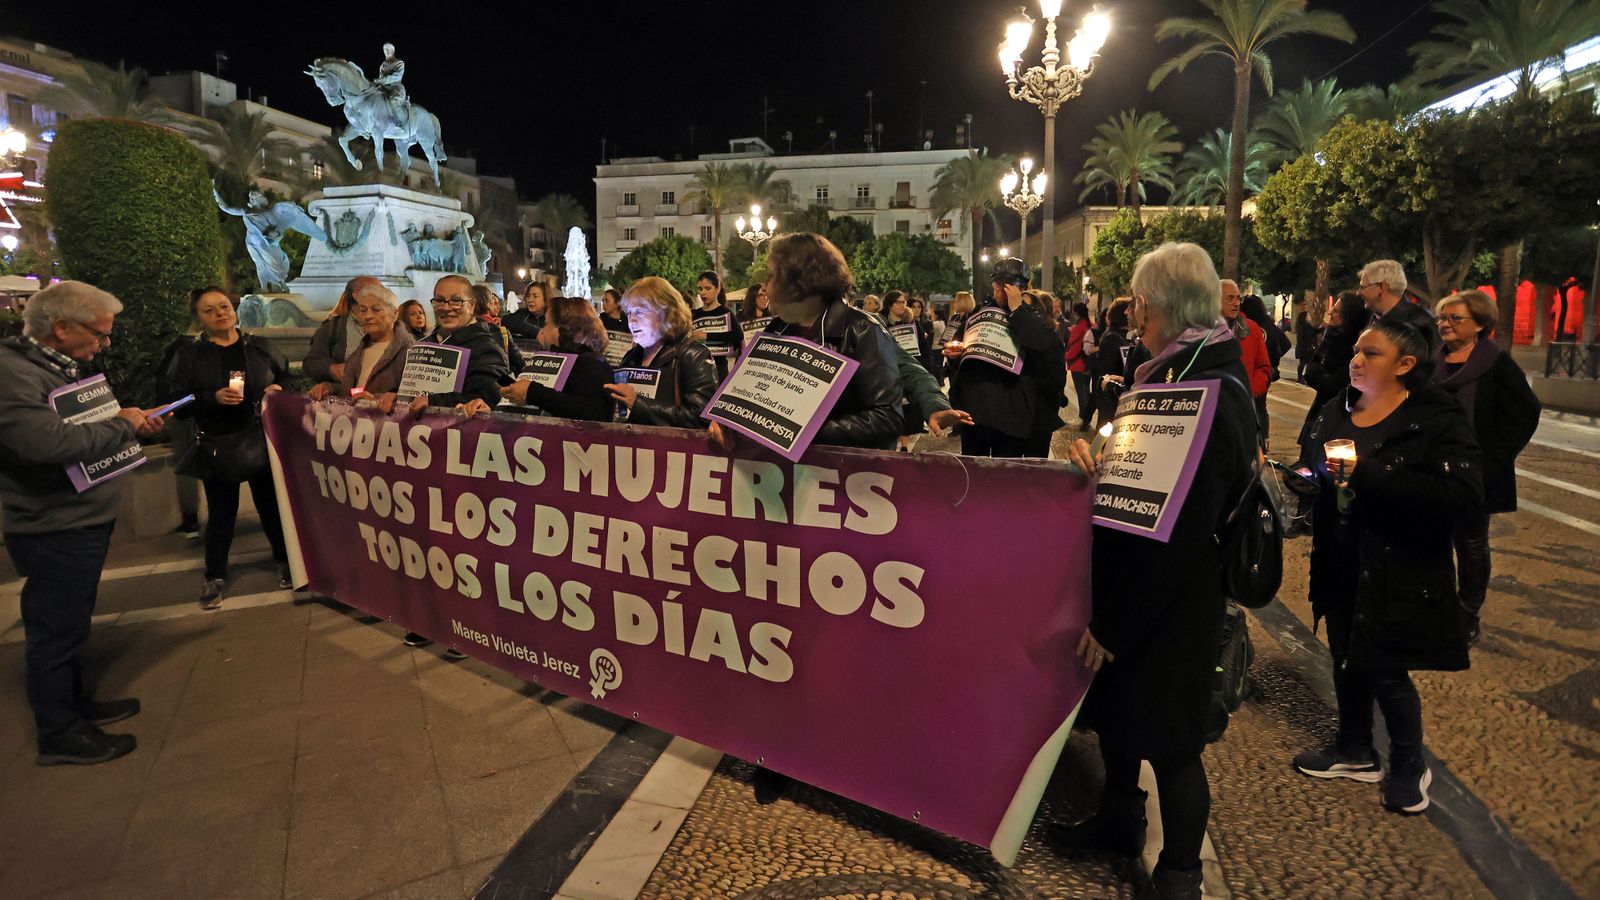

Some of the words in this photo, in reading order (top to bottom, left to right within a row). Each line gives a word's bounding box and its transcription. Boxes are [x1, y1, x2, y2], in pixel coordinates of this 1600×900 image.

[543, 360, 560, 369] años
[789, 348, 799, 359] G.
[799, 352, 813, 364] 52
[811, 357, 837, 375] años
[424, 366, 446, 377] pareja
[446, 370, 453, 378] y
[767, 361, 777, 371] con
[776, 364, 794, 377] arma
[793, 370, 819, 388] blanca
[76, 385, 111, 404] GEMMA
[754, 381, 770, 392] 2022
[771, 375, 777, 383] 8
[776, 376, 786, 387] de
[784, 378, 804, 395] junio
[753, 391, 778, 409] Ciudad
[777, 403, 795, 417] real
[1137, 399, 1158, 411] G.G.
[1158, 399, 1172, 411] 27
[1172, 398, 1199, 411] años
[751, 413, 795, 442] MACHISTA
[1139, 424, 1153, 433] su
[1151, 422, 1185, 438] pareja
[87, 457, 113, 475] STOP
[1123, 450, 1147, 464] 2022
[314, 411, 432, 470] TODAS
[446, 428, 546, 487] LAS
[562, 440, 898, 535] MUJERES
[1108, 464, 1144, 481] Alicante
[1111, 495, 1160, 517] MACHISTA
[311, 460, 416, 525] TODOS
[428, 487, 517, 547] LOS
[532, 504, 925, 628] DERECHOS
[358, 522, 482, 599] TODOS
[494, 562, 595, 632] LOS
[613, 590, 794, 682] DÍAS
[451, 619, 490, 648] Marea
[490, 633, 539, 665] Violeta
[541, 651, 581, 680] Jerez
